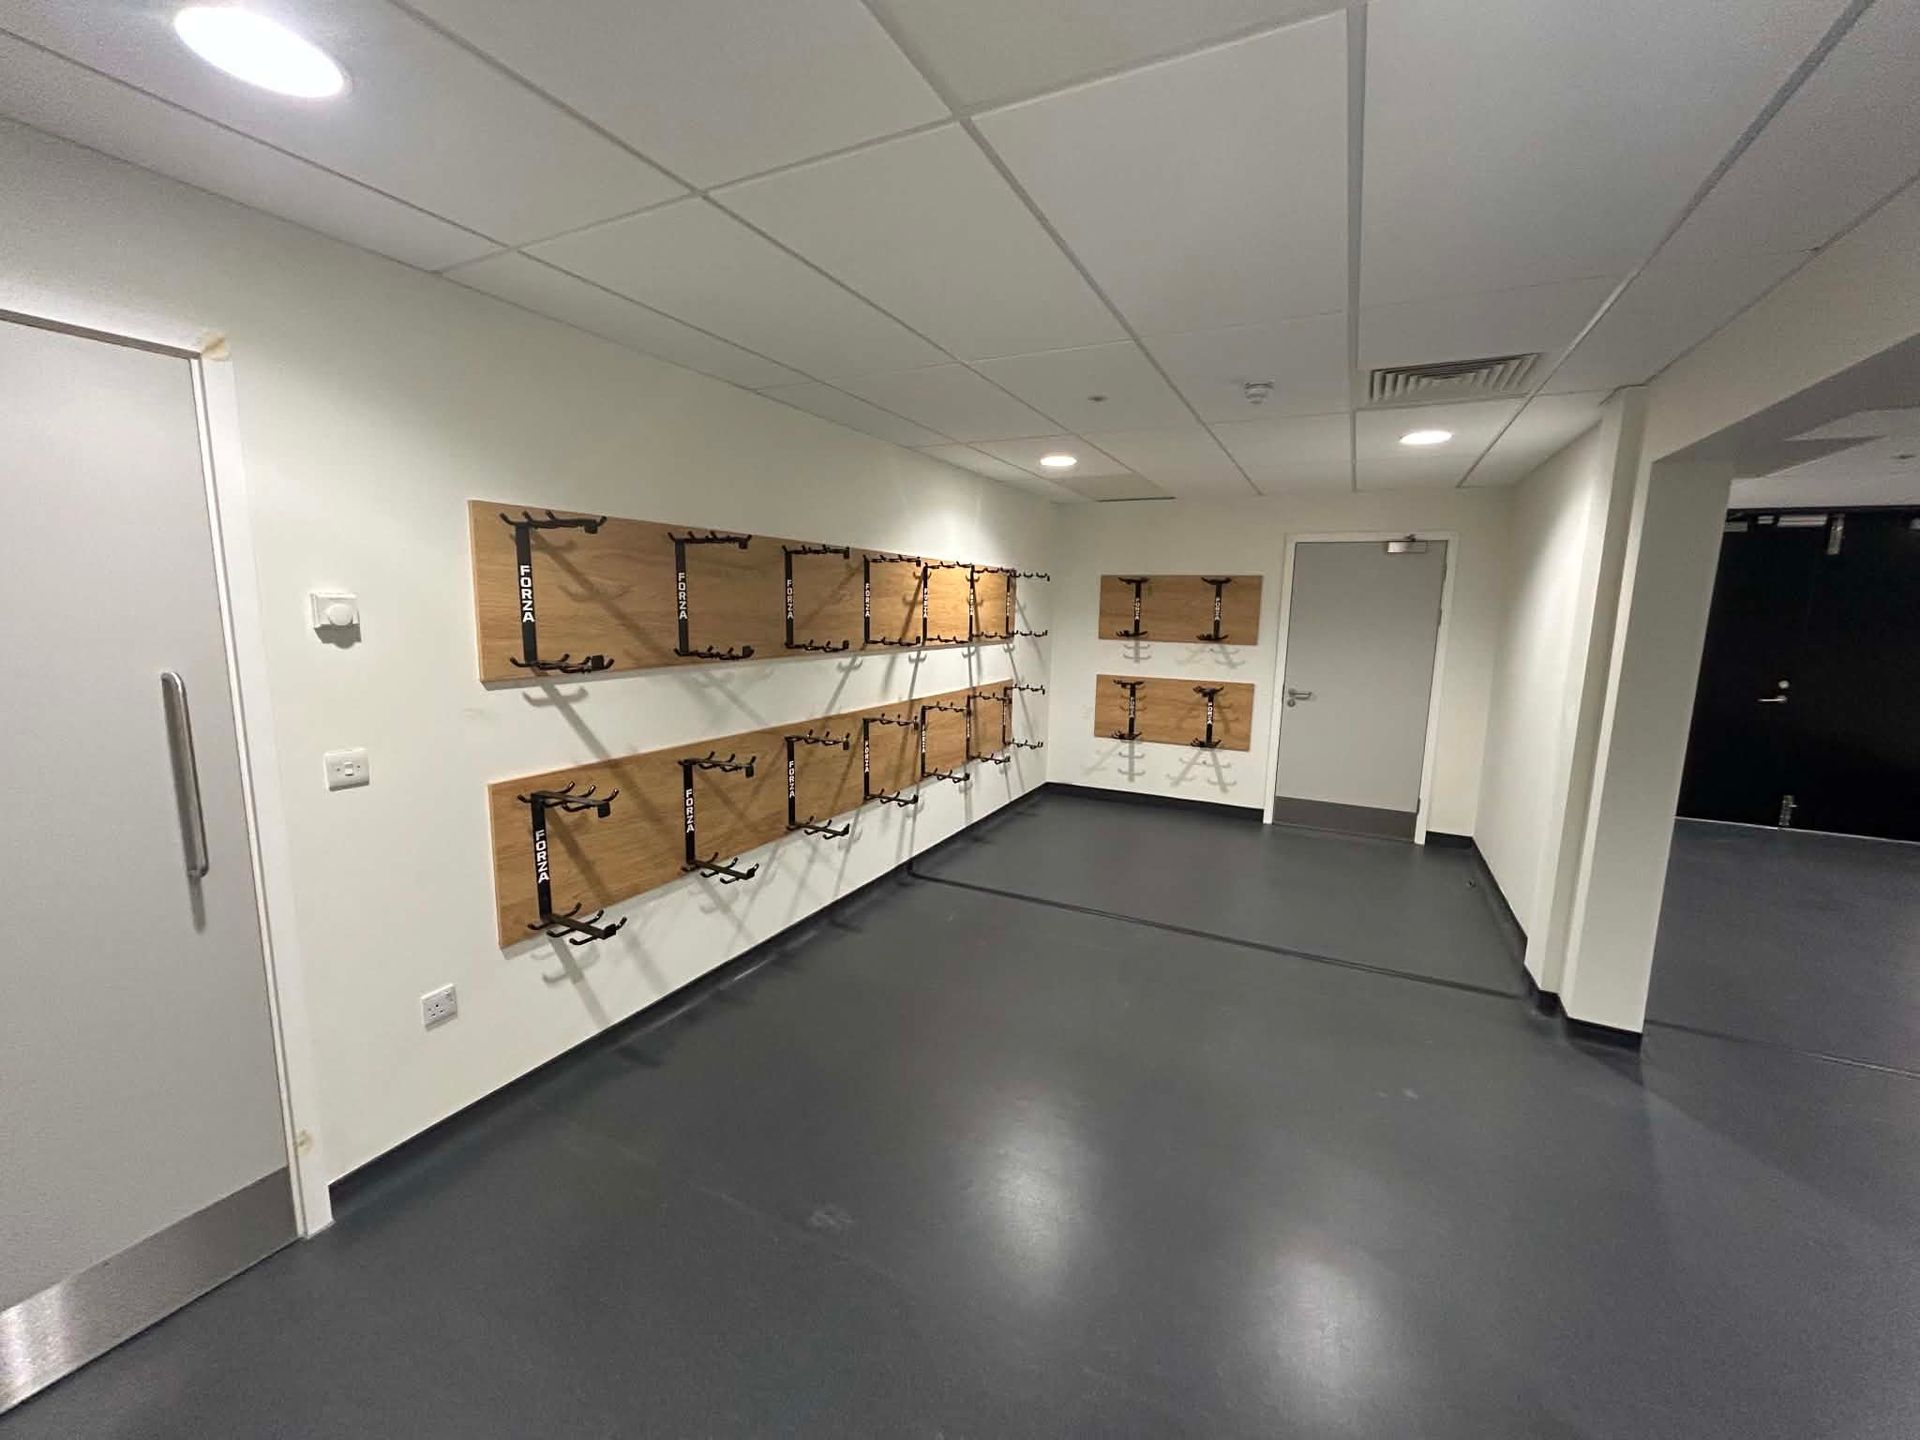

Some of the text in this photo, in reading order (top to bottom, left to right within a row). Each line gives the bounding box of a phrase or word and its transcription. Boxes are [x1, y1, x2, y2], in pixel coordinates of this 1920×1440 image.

[520, 565, 535, 622] FORZA
[678, 572, 688, 619] FORZA
[686, 788, 695, 833] FORZA
[535, 830, 550, 883] FORZA
